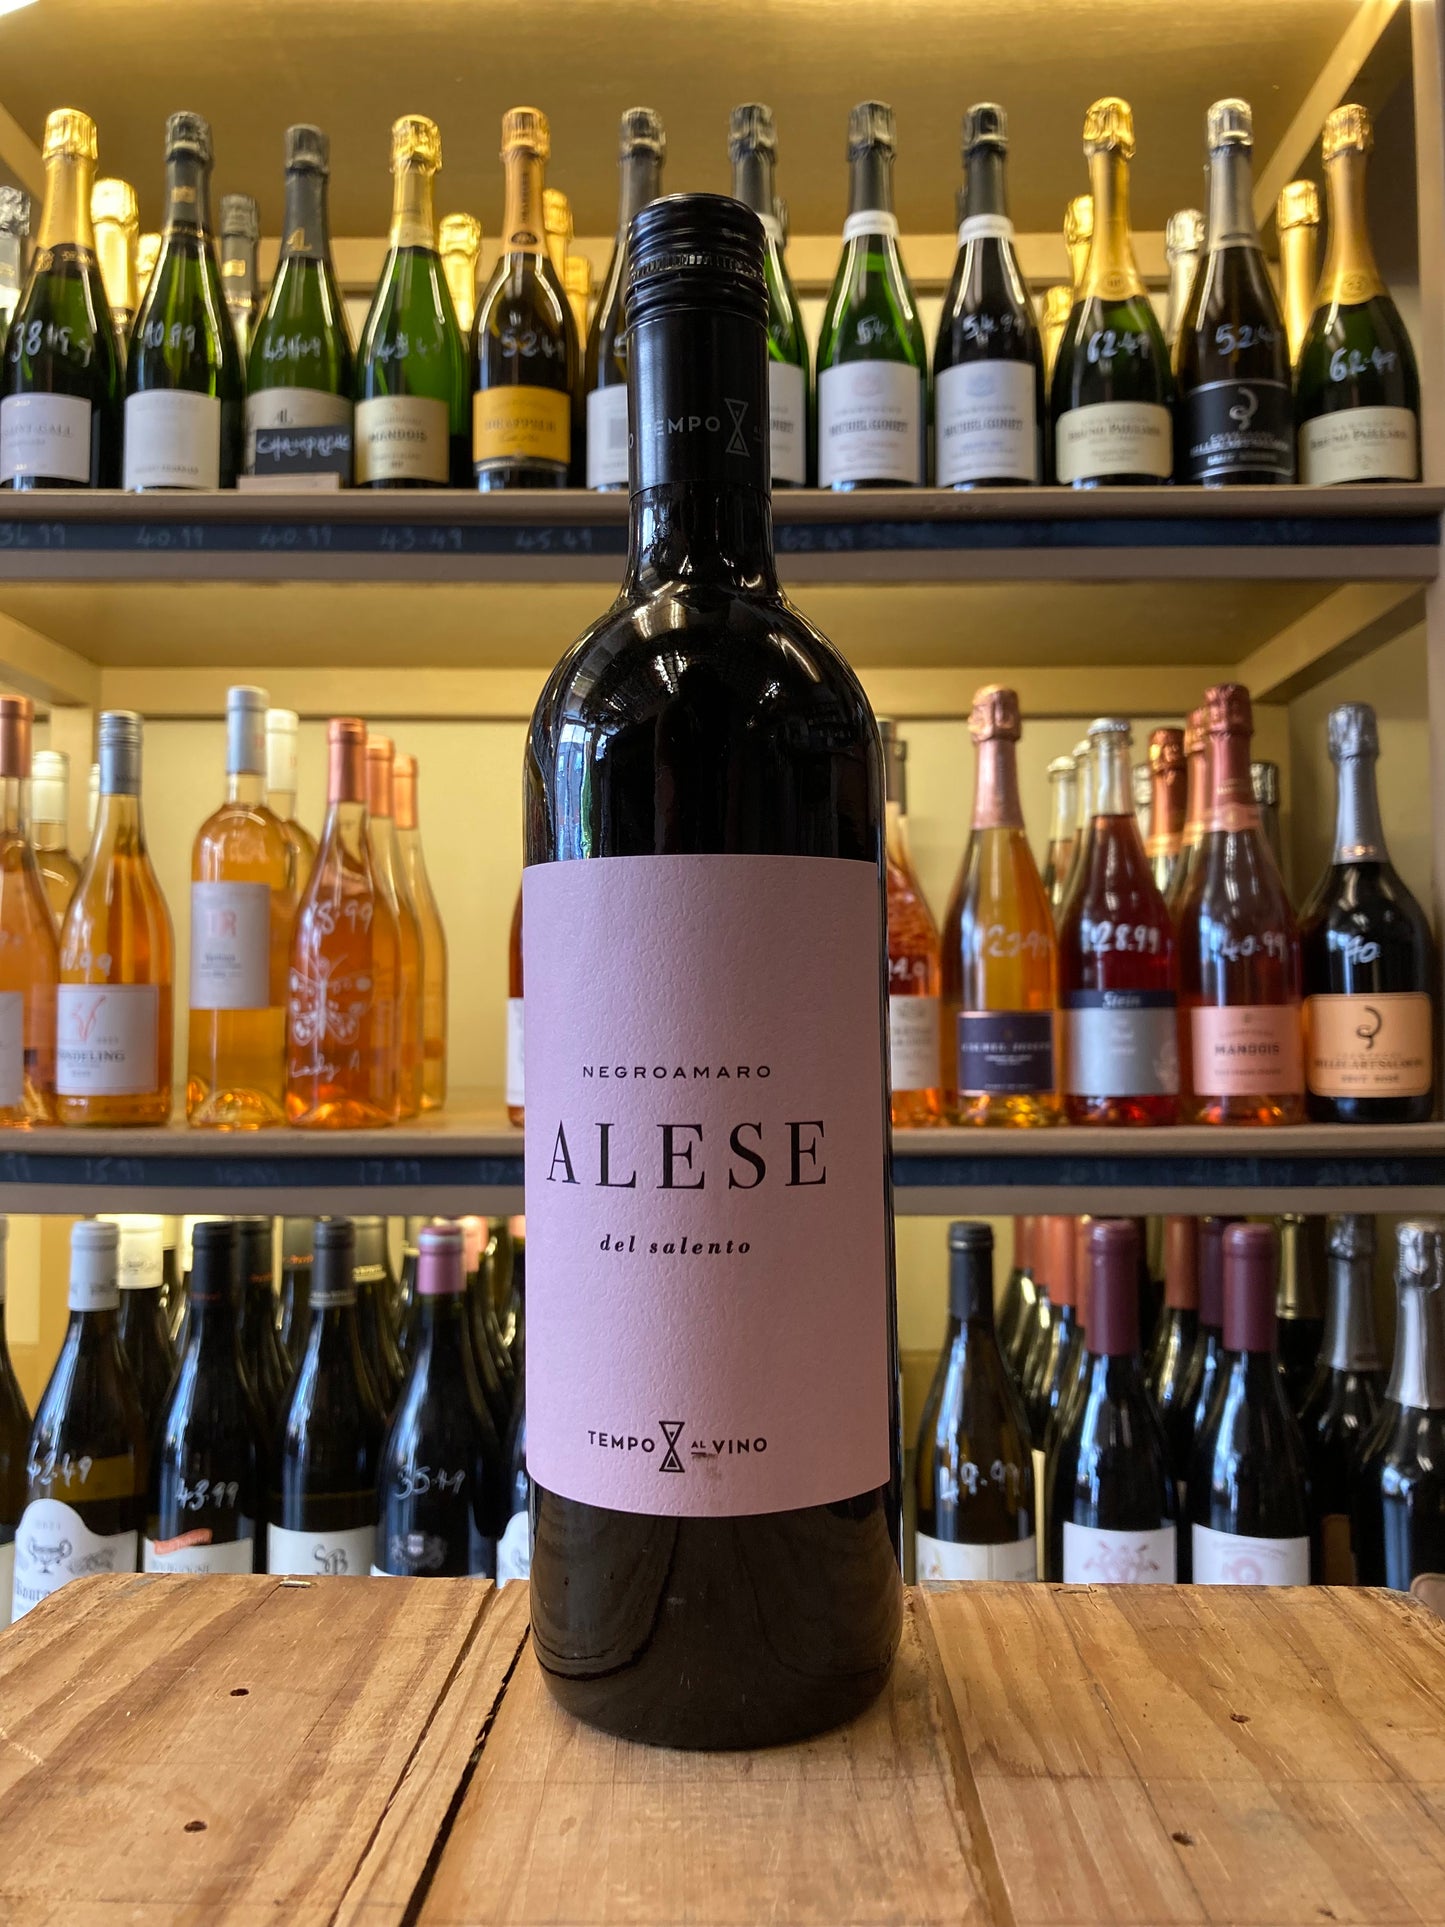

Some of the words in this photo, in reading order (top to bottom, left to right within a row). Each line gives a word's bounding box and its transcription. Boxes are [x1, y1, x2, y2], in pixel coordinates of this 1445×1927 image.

[655, 415, 721, 436] EMPO
[582, 1064, 773, 1080] NEGROAMARO
[546, 1119, 828, 1191] ALESE
[599, 1233, 636, 1253] del
[649, 1236, 752, 1255] salento
[587, 1430, 656, 1453] TEMPO
[690, 1440, 707, 1449] AL
[712, 1437, 768, 1454] VINO
